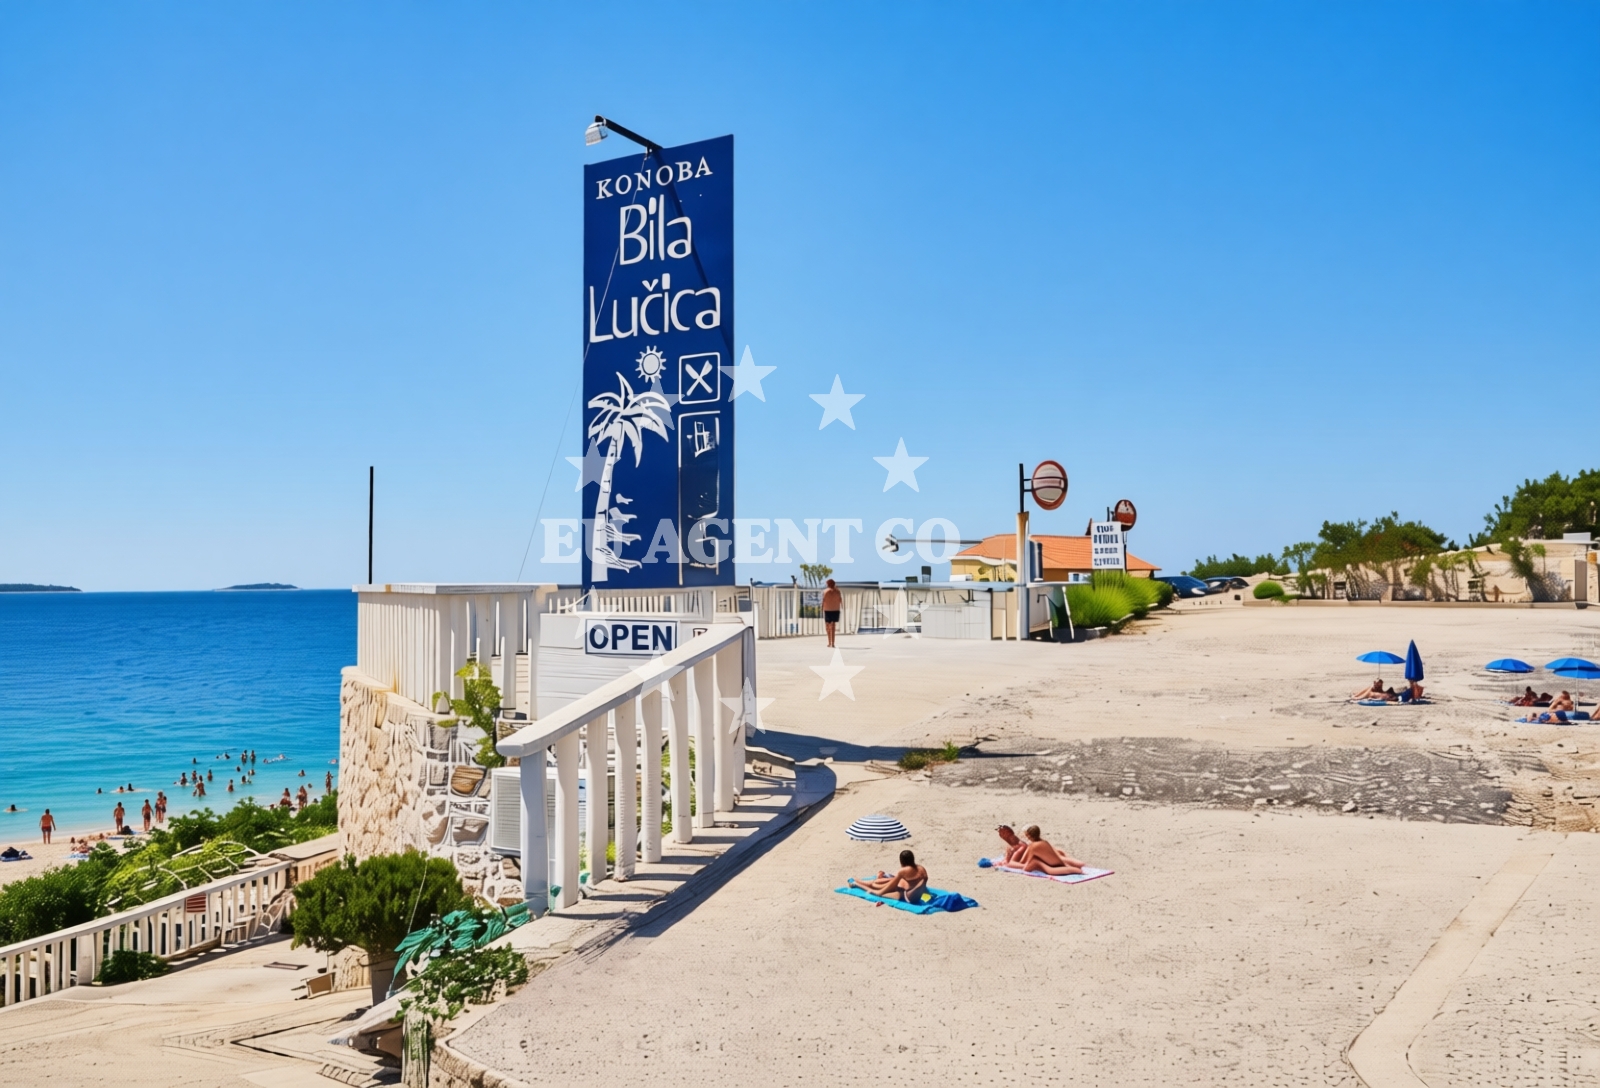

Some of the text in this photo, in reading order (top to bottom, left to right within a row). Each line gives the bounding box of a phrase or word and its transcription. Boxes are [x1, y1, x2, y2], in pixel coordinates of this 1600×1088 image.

[595, 156, 713, 200] KONOBA
[619, 194, 692, 265] Bila
[589, 273, 721, 343] Lučica
[589, 624, 673, 651] OPEN
